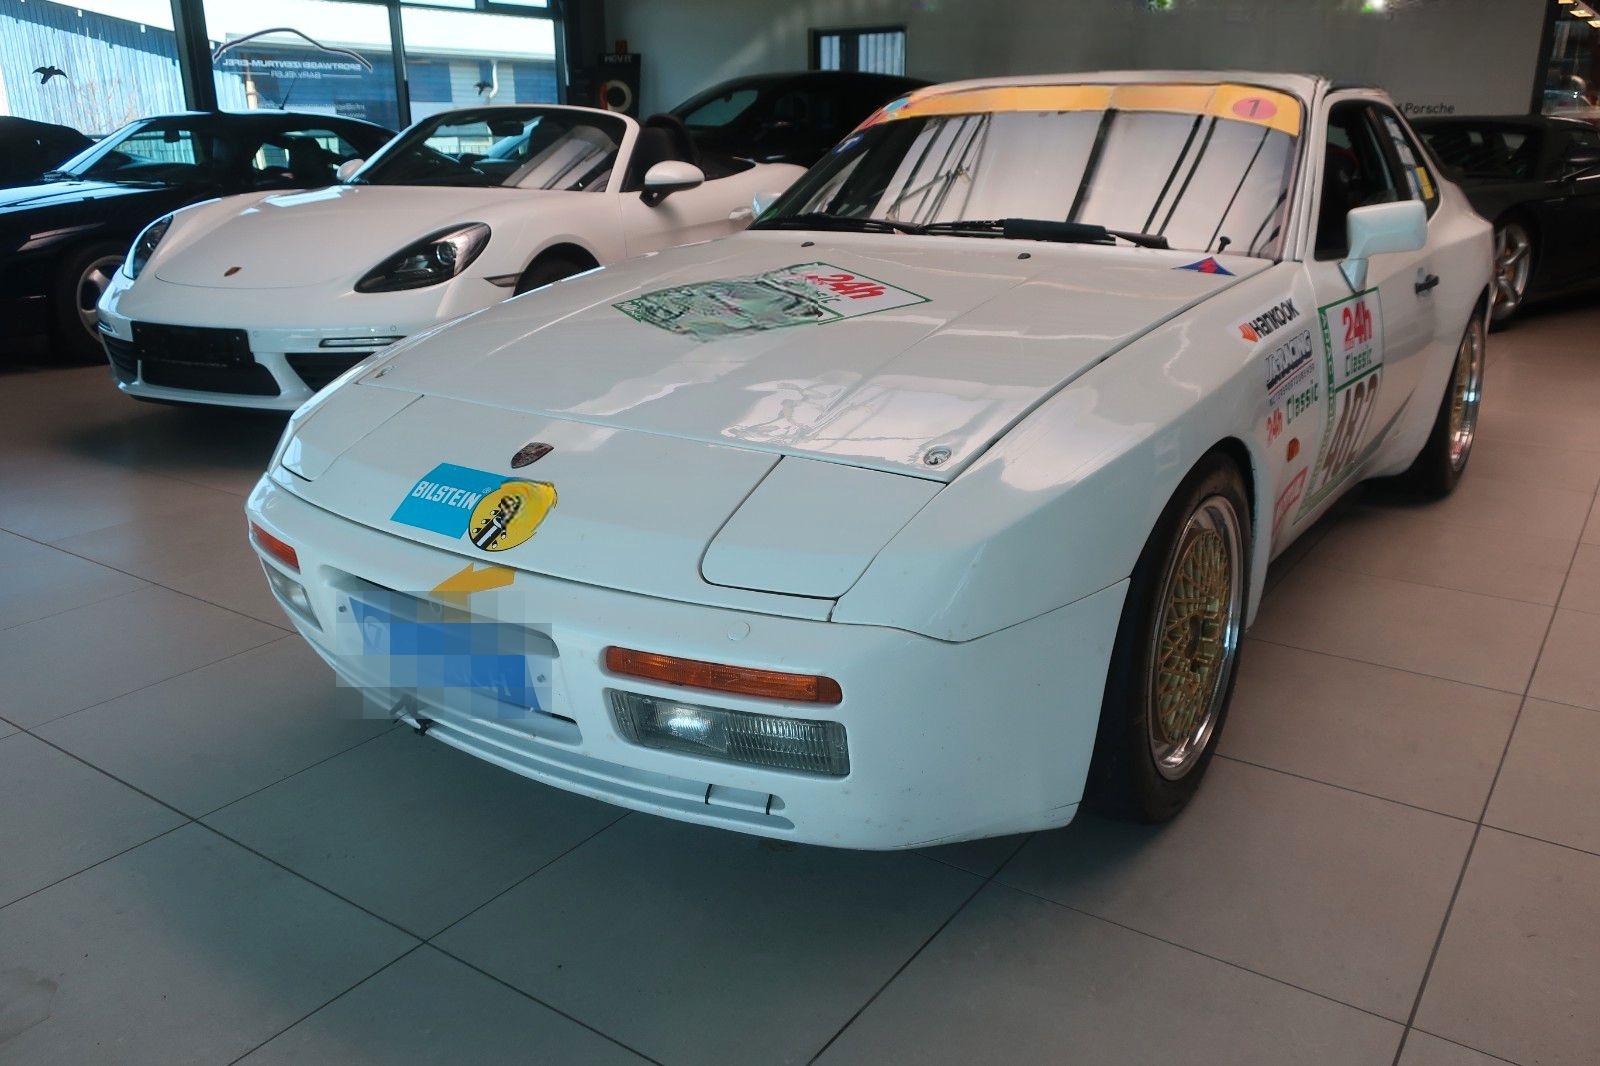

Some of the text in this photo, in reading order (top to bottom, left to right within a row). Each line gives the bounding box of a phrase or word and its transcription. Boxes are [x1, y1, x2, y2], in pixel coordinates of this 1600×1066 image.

[1404, 102, 1456, 115] Porsche
[1342, 301, 1373, 351] 24h
[1285, 379, 1320, 425] Classic
[411, 480, 483, 510] BILSTEIN
